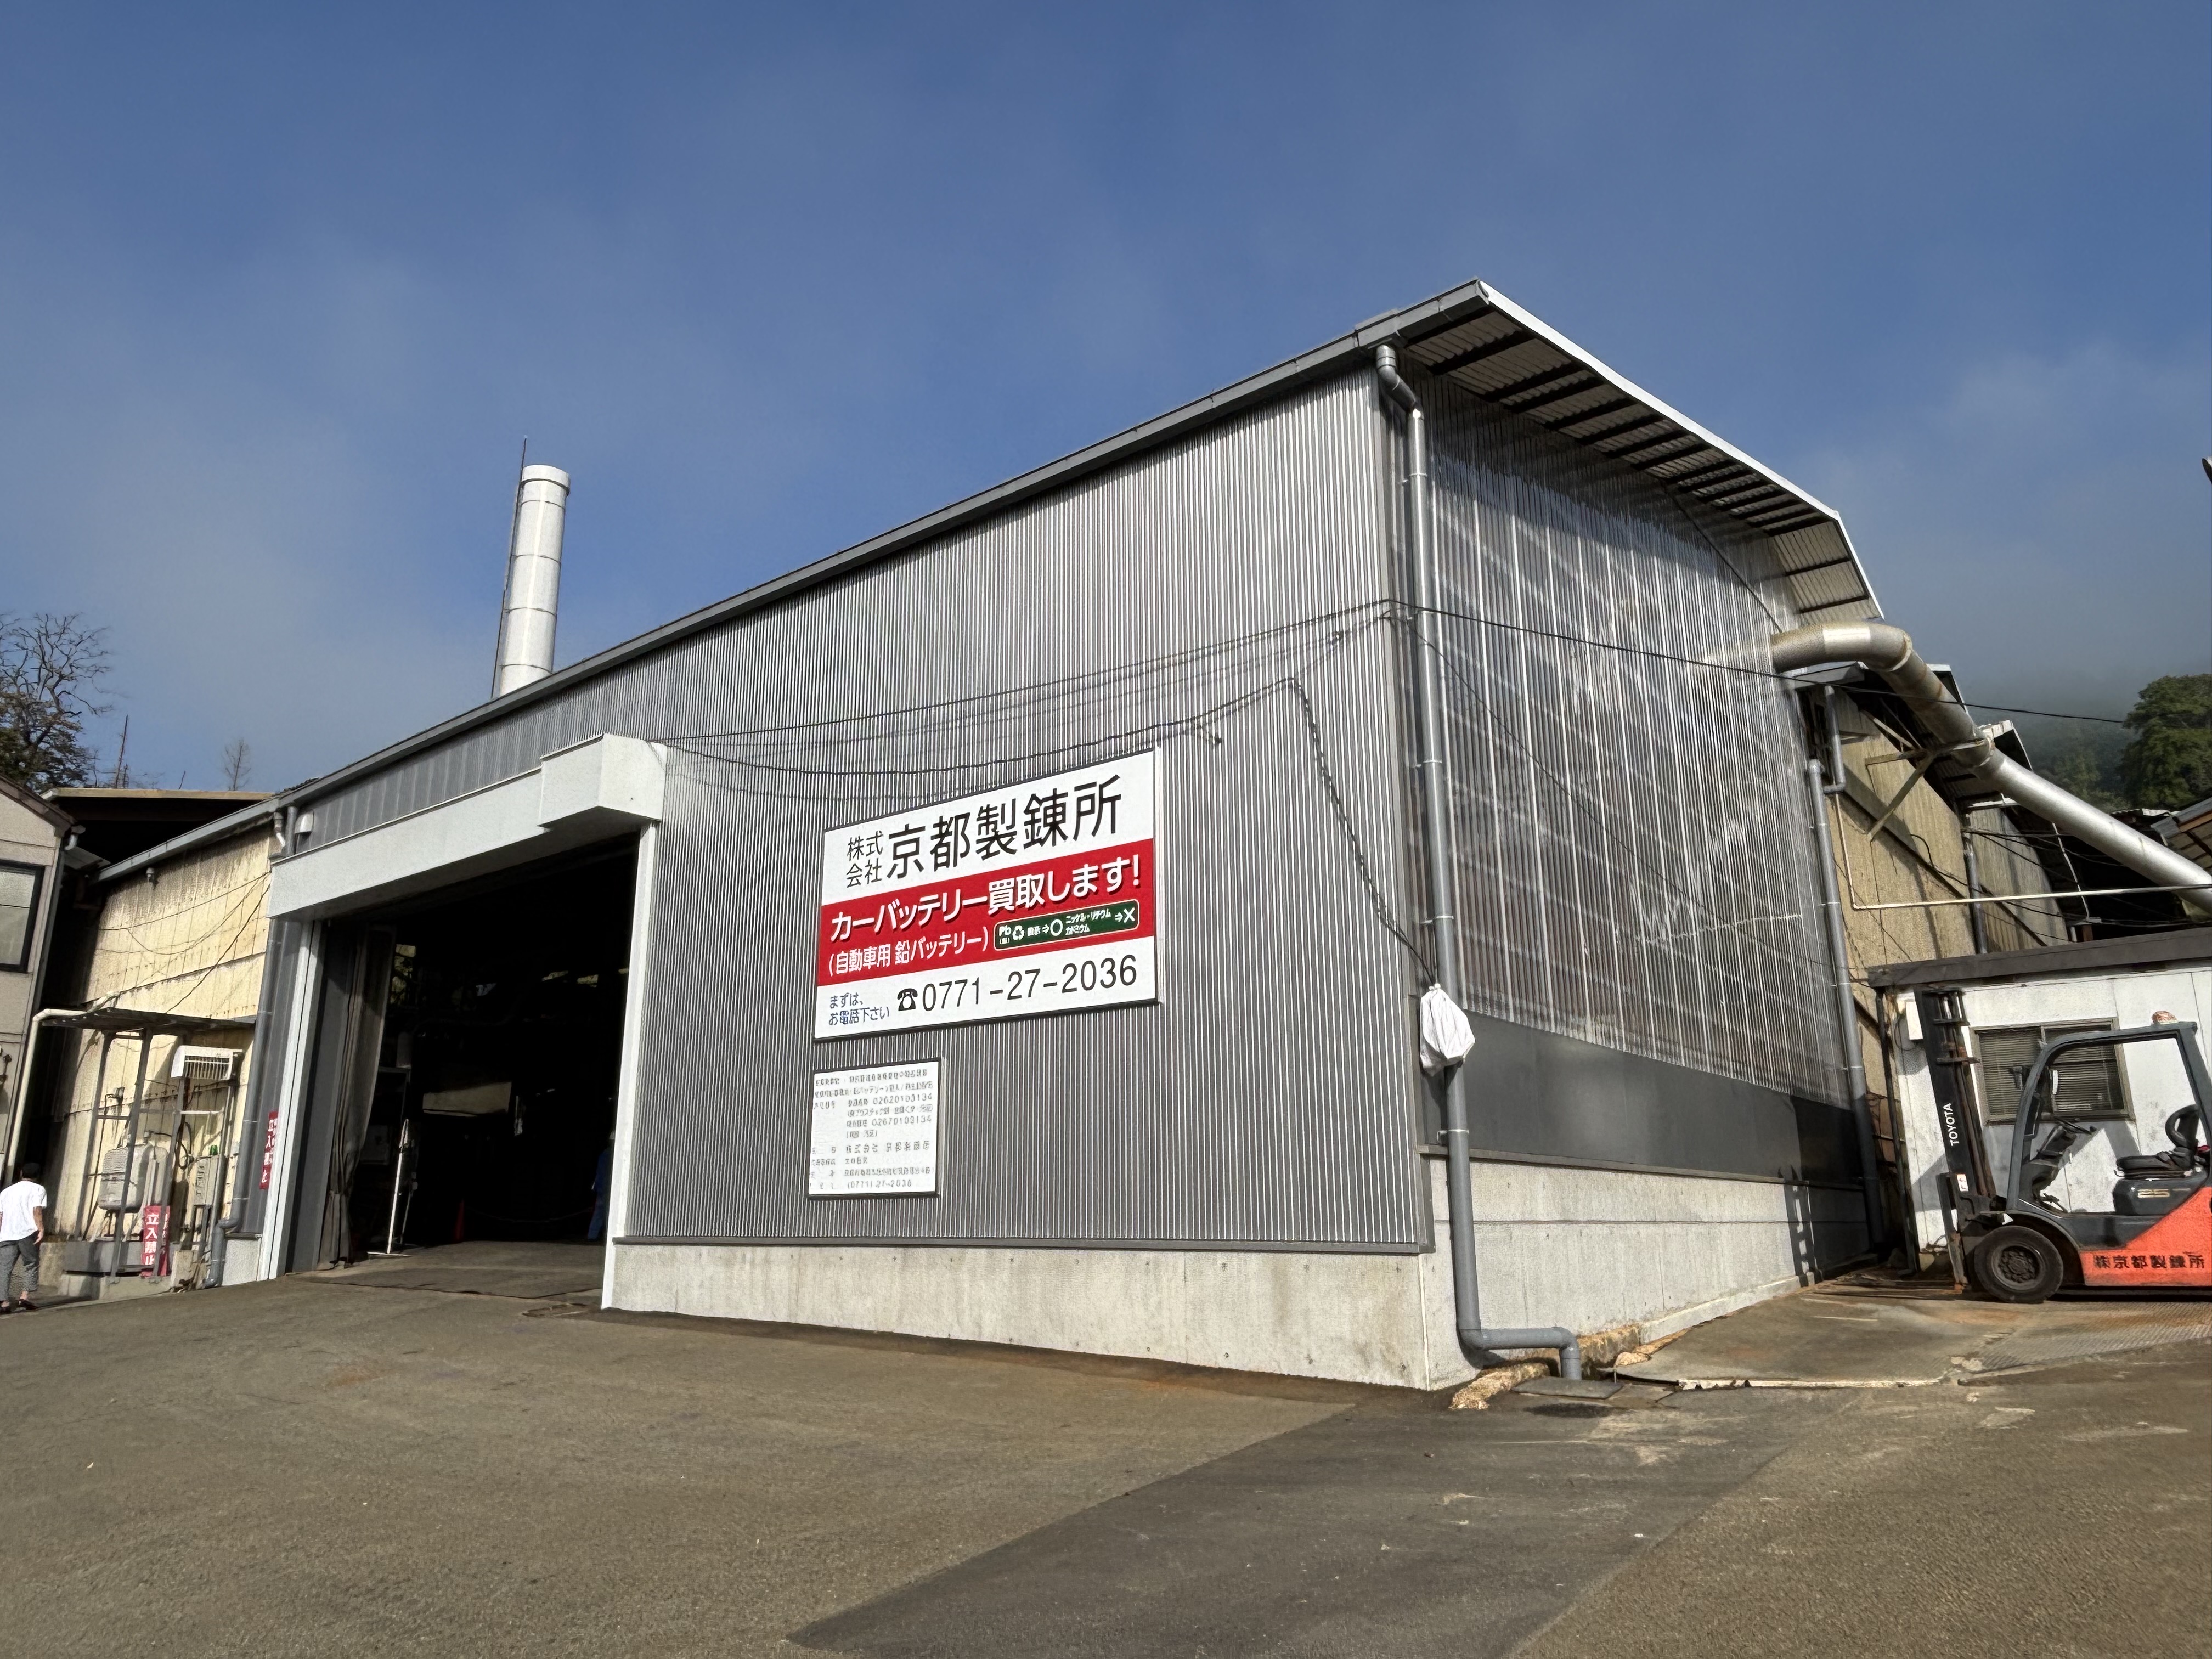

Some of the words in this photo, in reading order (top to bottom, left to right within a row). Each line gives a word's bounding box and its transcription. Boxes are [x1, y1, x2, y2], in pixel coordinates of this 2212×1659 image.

[887, 774, 1121, 879] 京都製錬所
[999, 925, 1012, 936] Pb
[922, 954, 1137, 1012] 0771-27-2036
[1943, 1103, 1960, 1147] TOYOTA
